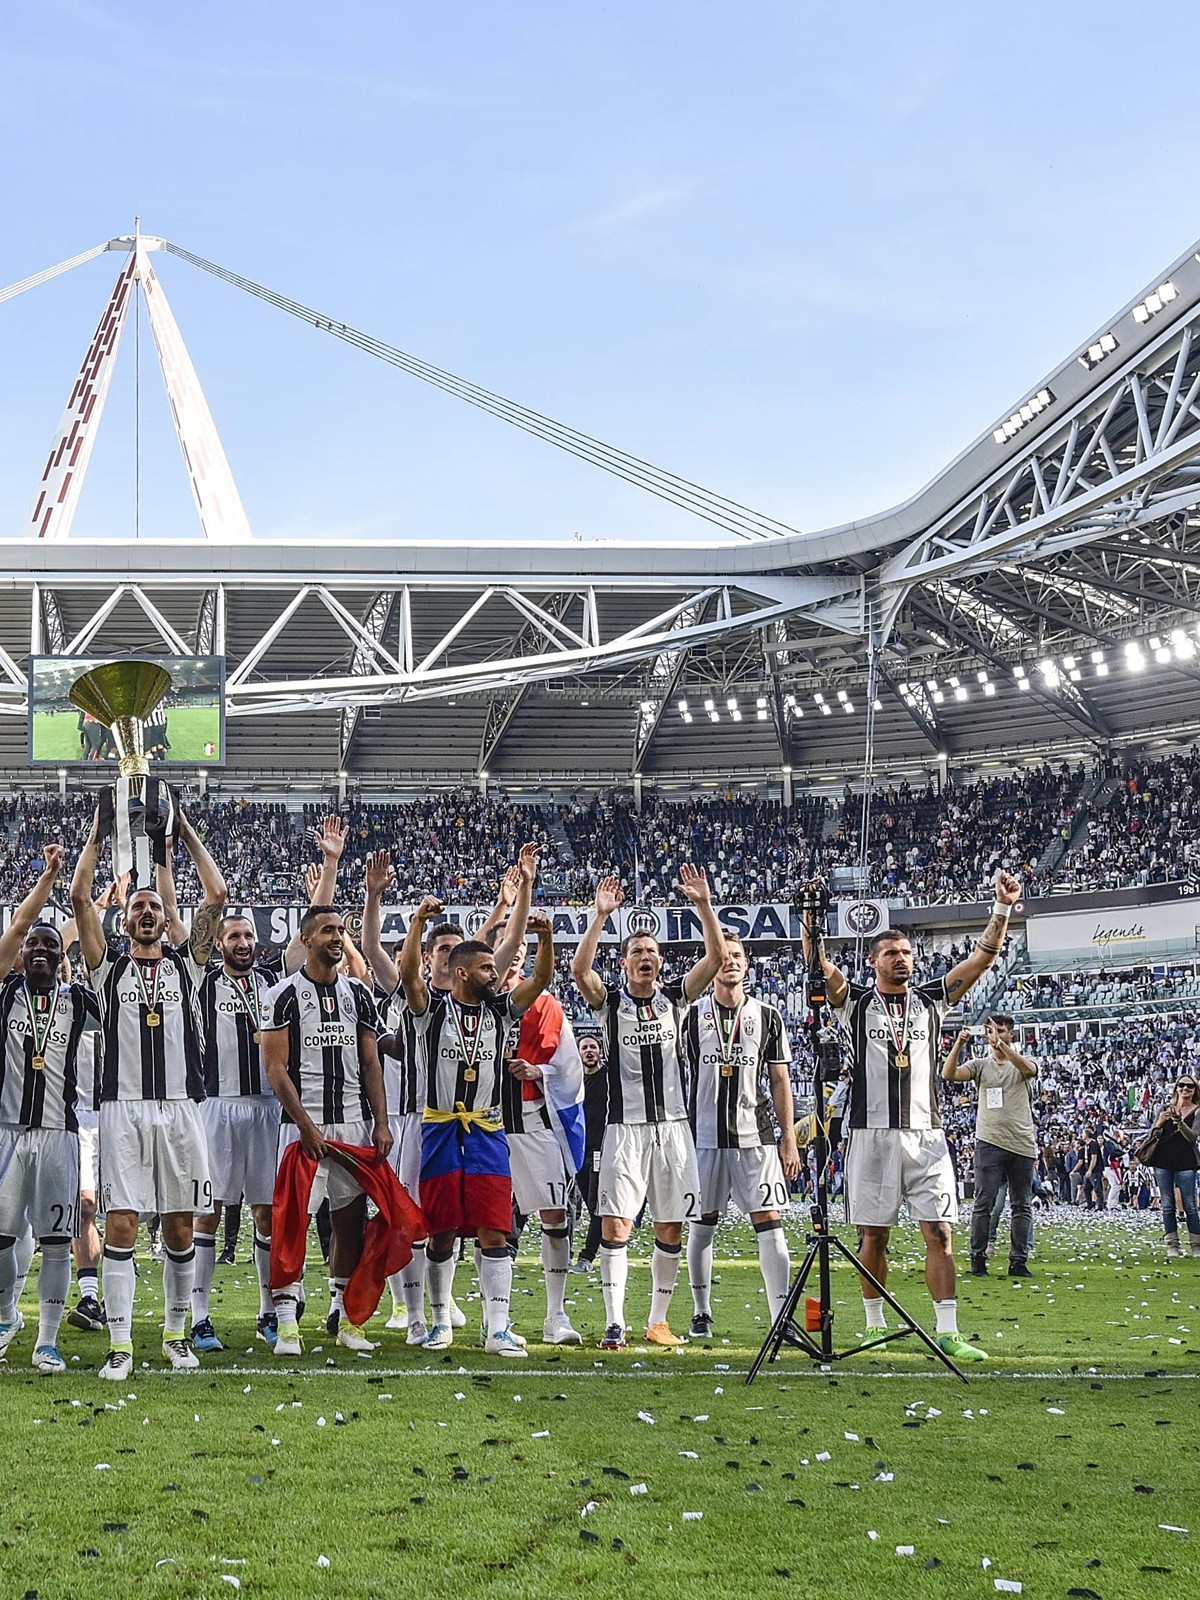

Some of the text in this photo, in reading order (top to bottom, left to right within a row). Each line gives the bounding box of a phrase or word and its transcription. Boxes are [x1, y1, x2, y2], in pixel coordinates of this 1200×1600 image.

[1092, 923, 1146, 947] Legends
[120, 991, 181, 1004] COASS
[8, 1019, 68, 1045] COMPSS
[317, 1023, 346, 1034] Jeep
[633, 1022, 663, 1034] Jeep
[303, 1036, 356, 1047] COMPASS
[623, 1032, 675, 1046] COMPASS
[441, 1048, 493, 1061] COASS
[191, 1179, 212, 1209] 19
[547, 1181, 566, 1206] 17
[759, 1182, 787, 1207] 20
[51, 1203, 73, 1233] 22
